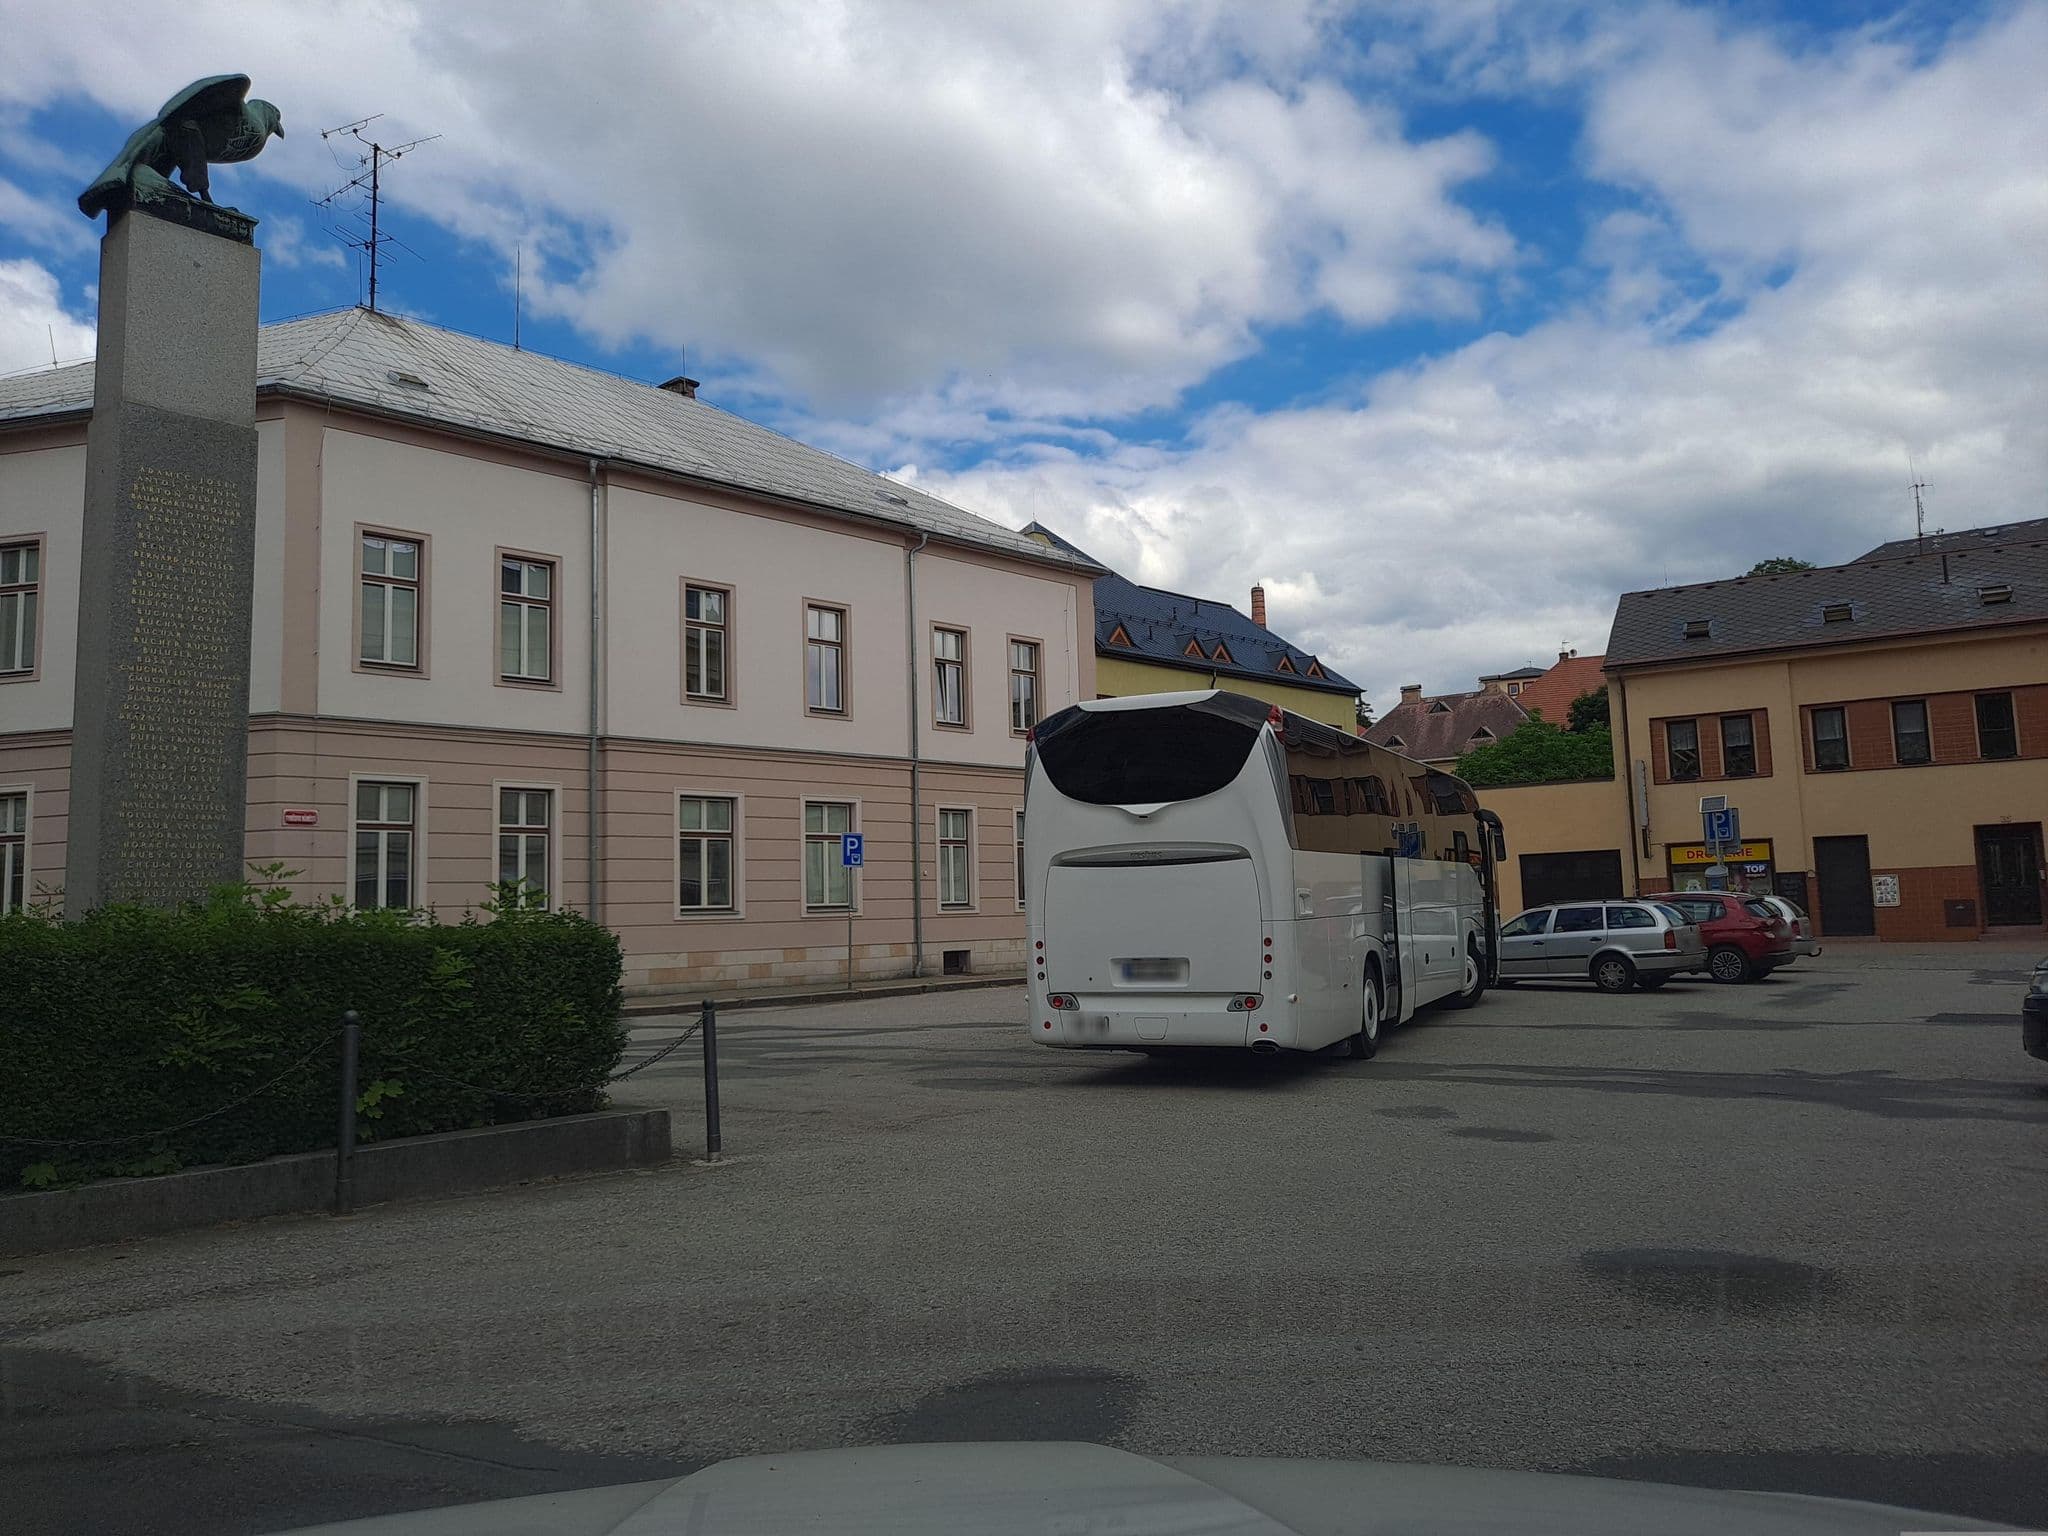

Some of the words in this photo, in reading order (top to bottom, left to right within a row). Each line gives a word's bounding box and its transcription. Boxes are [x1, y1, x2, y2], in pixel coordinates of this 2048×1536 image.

[212, 589, 235, 597] JAN
[1712, 813, 1725, 832] P
[847, 838, 858, 856] P
[1686, 848, 1752, 859] DROERIE
[1745, 865, 1765, 873] TOP
